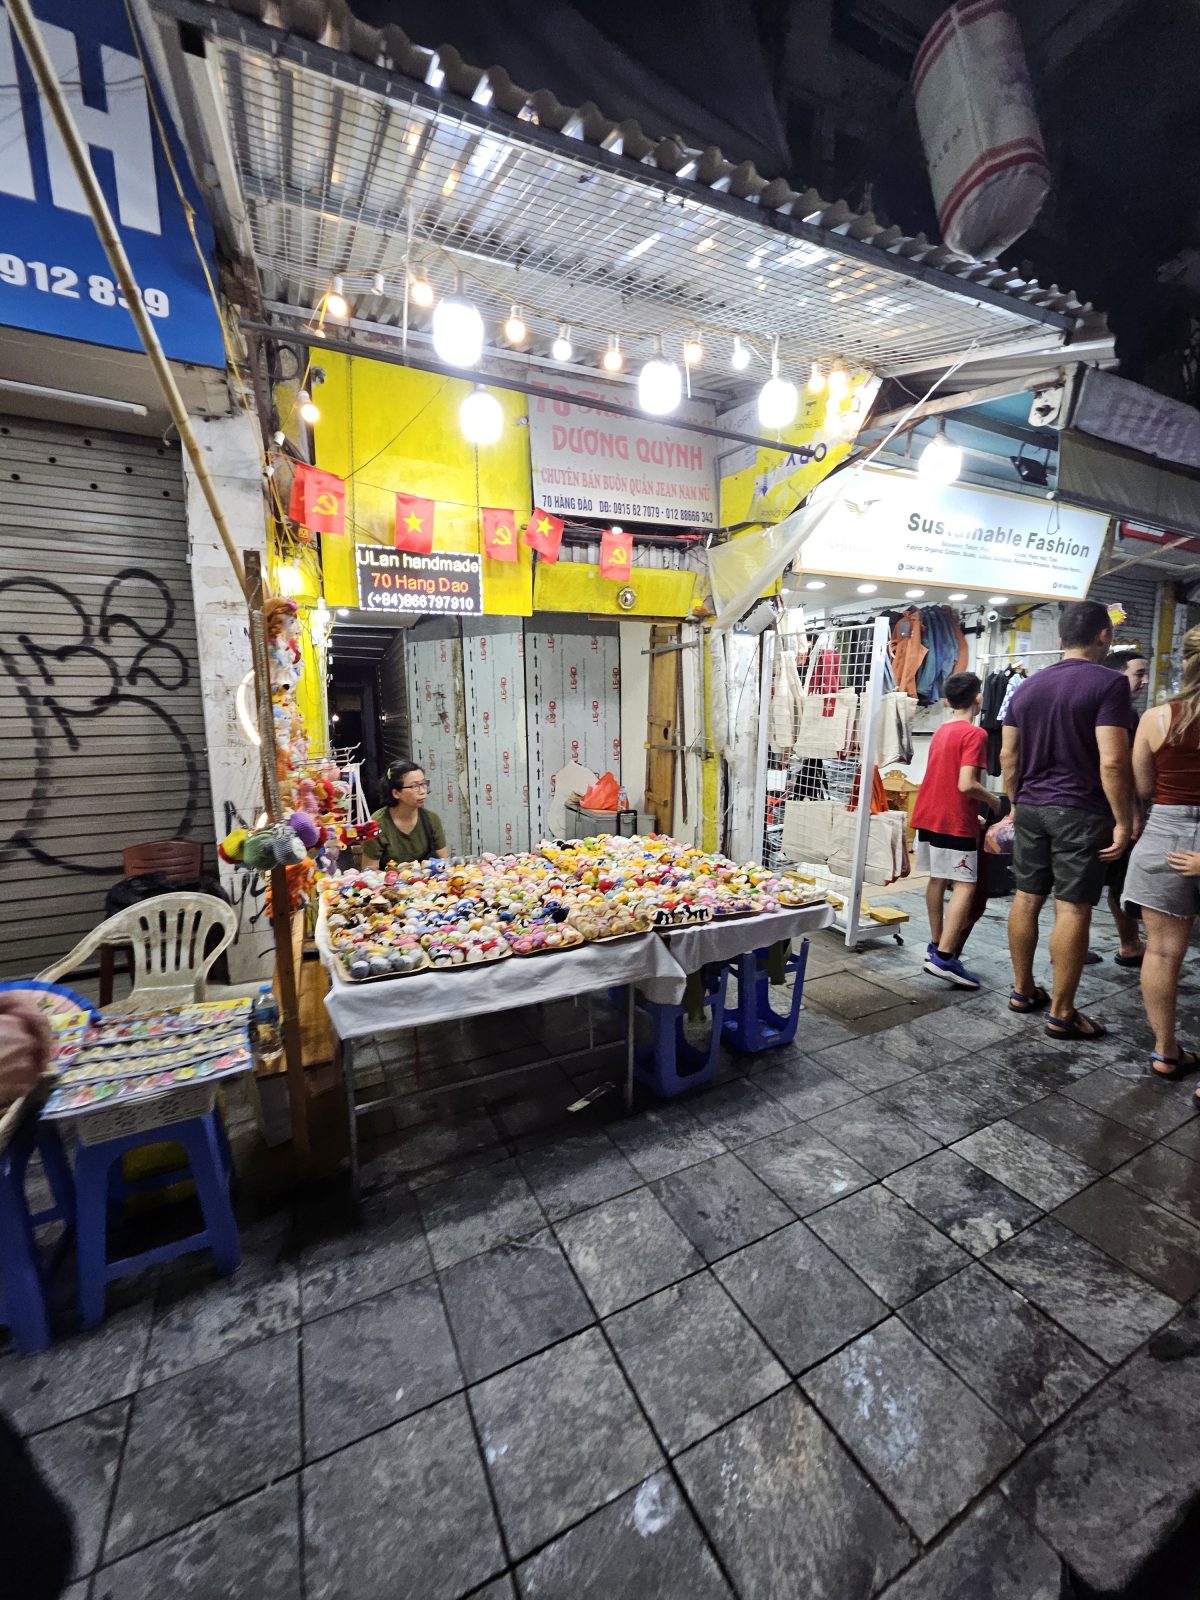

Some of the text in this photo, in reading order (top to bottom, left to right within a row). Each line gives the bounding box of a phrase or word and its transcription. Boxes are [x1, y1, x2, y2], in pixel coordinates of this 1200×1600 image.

[552, 424, 629, 461] DƯƠNG
[635, 436, 703, 471] QUỲNH
[540, 466, 579, 487] CHUYÊN
[656, 481, 678, 498] JEAN
[541, 494, 553, 508] 70
[613, 501, 631, 516] 0915
[632, 503, 642, 516] 62
[643, 505, 660, 519] 7079
[665, 507, 679, 520] 012
[701, 511, 713, 524] 343
[907, 512, 1023, 547] Susnable
[1026, 532, 1090, 558] Fashion
[402, 553, 479, 573] handmade
[371, 572, 469, 593] 70 Hang Dao
